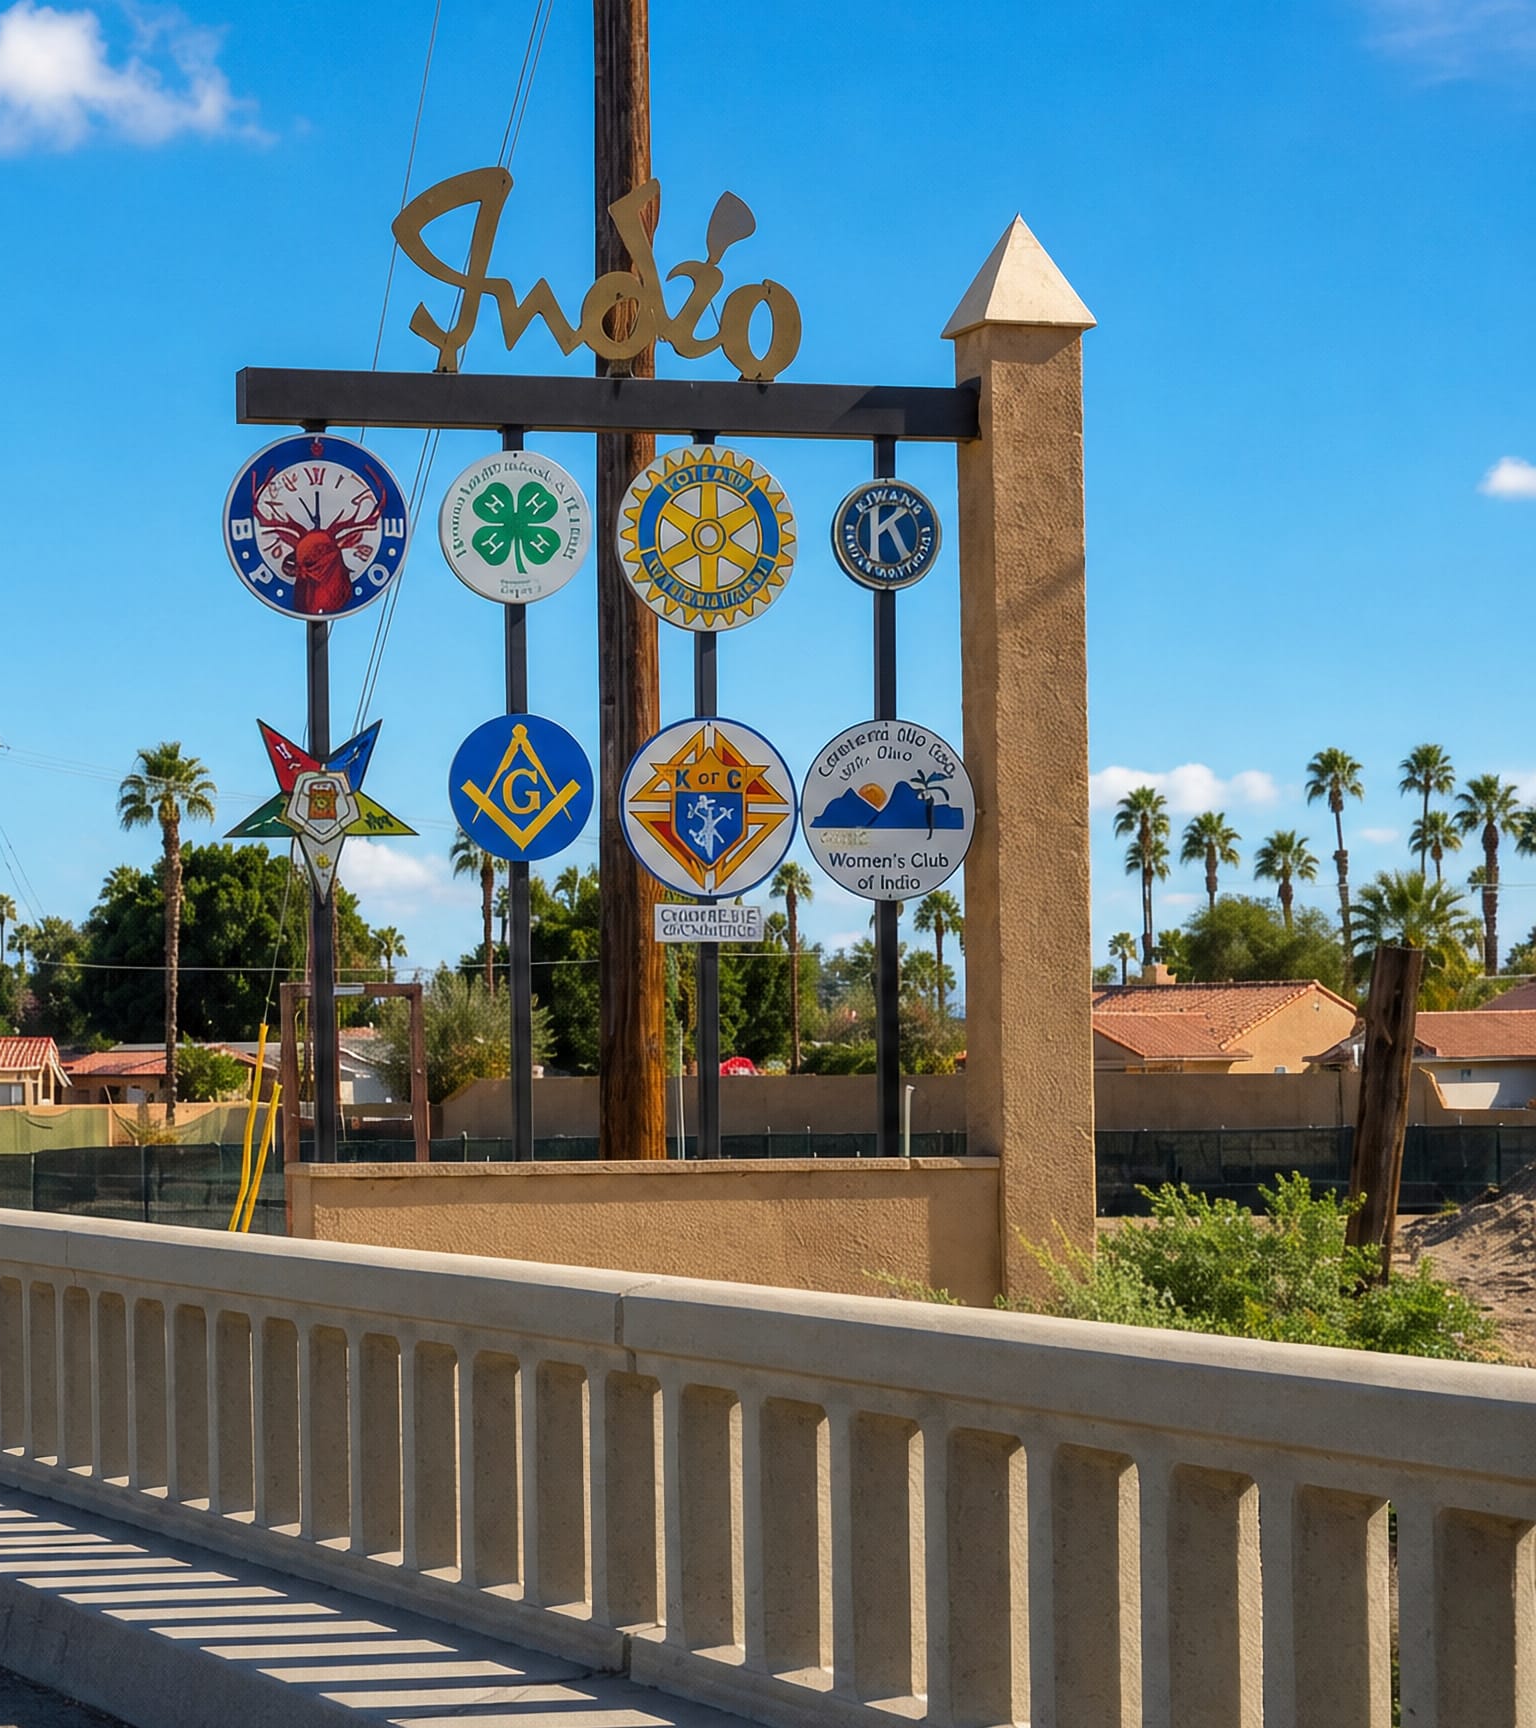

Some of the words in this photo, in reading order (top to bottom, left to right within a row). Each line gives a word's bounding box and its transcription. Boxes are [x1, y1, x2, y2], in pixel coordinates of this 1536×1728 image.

[392, 166, 802, 382] Indio
[869, 505, 912, 562] K
[502, 768, 541, 815] G
[675, 768, 691, 789] K
[726, 769, 742, 789] C
[829, 853, 906, 869] Women's
[911, 853, 949, 868] Club
[858, 875, 875, 890] of
[880, 875, 921, 890] Indio
